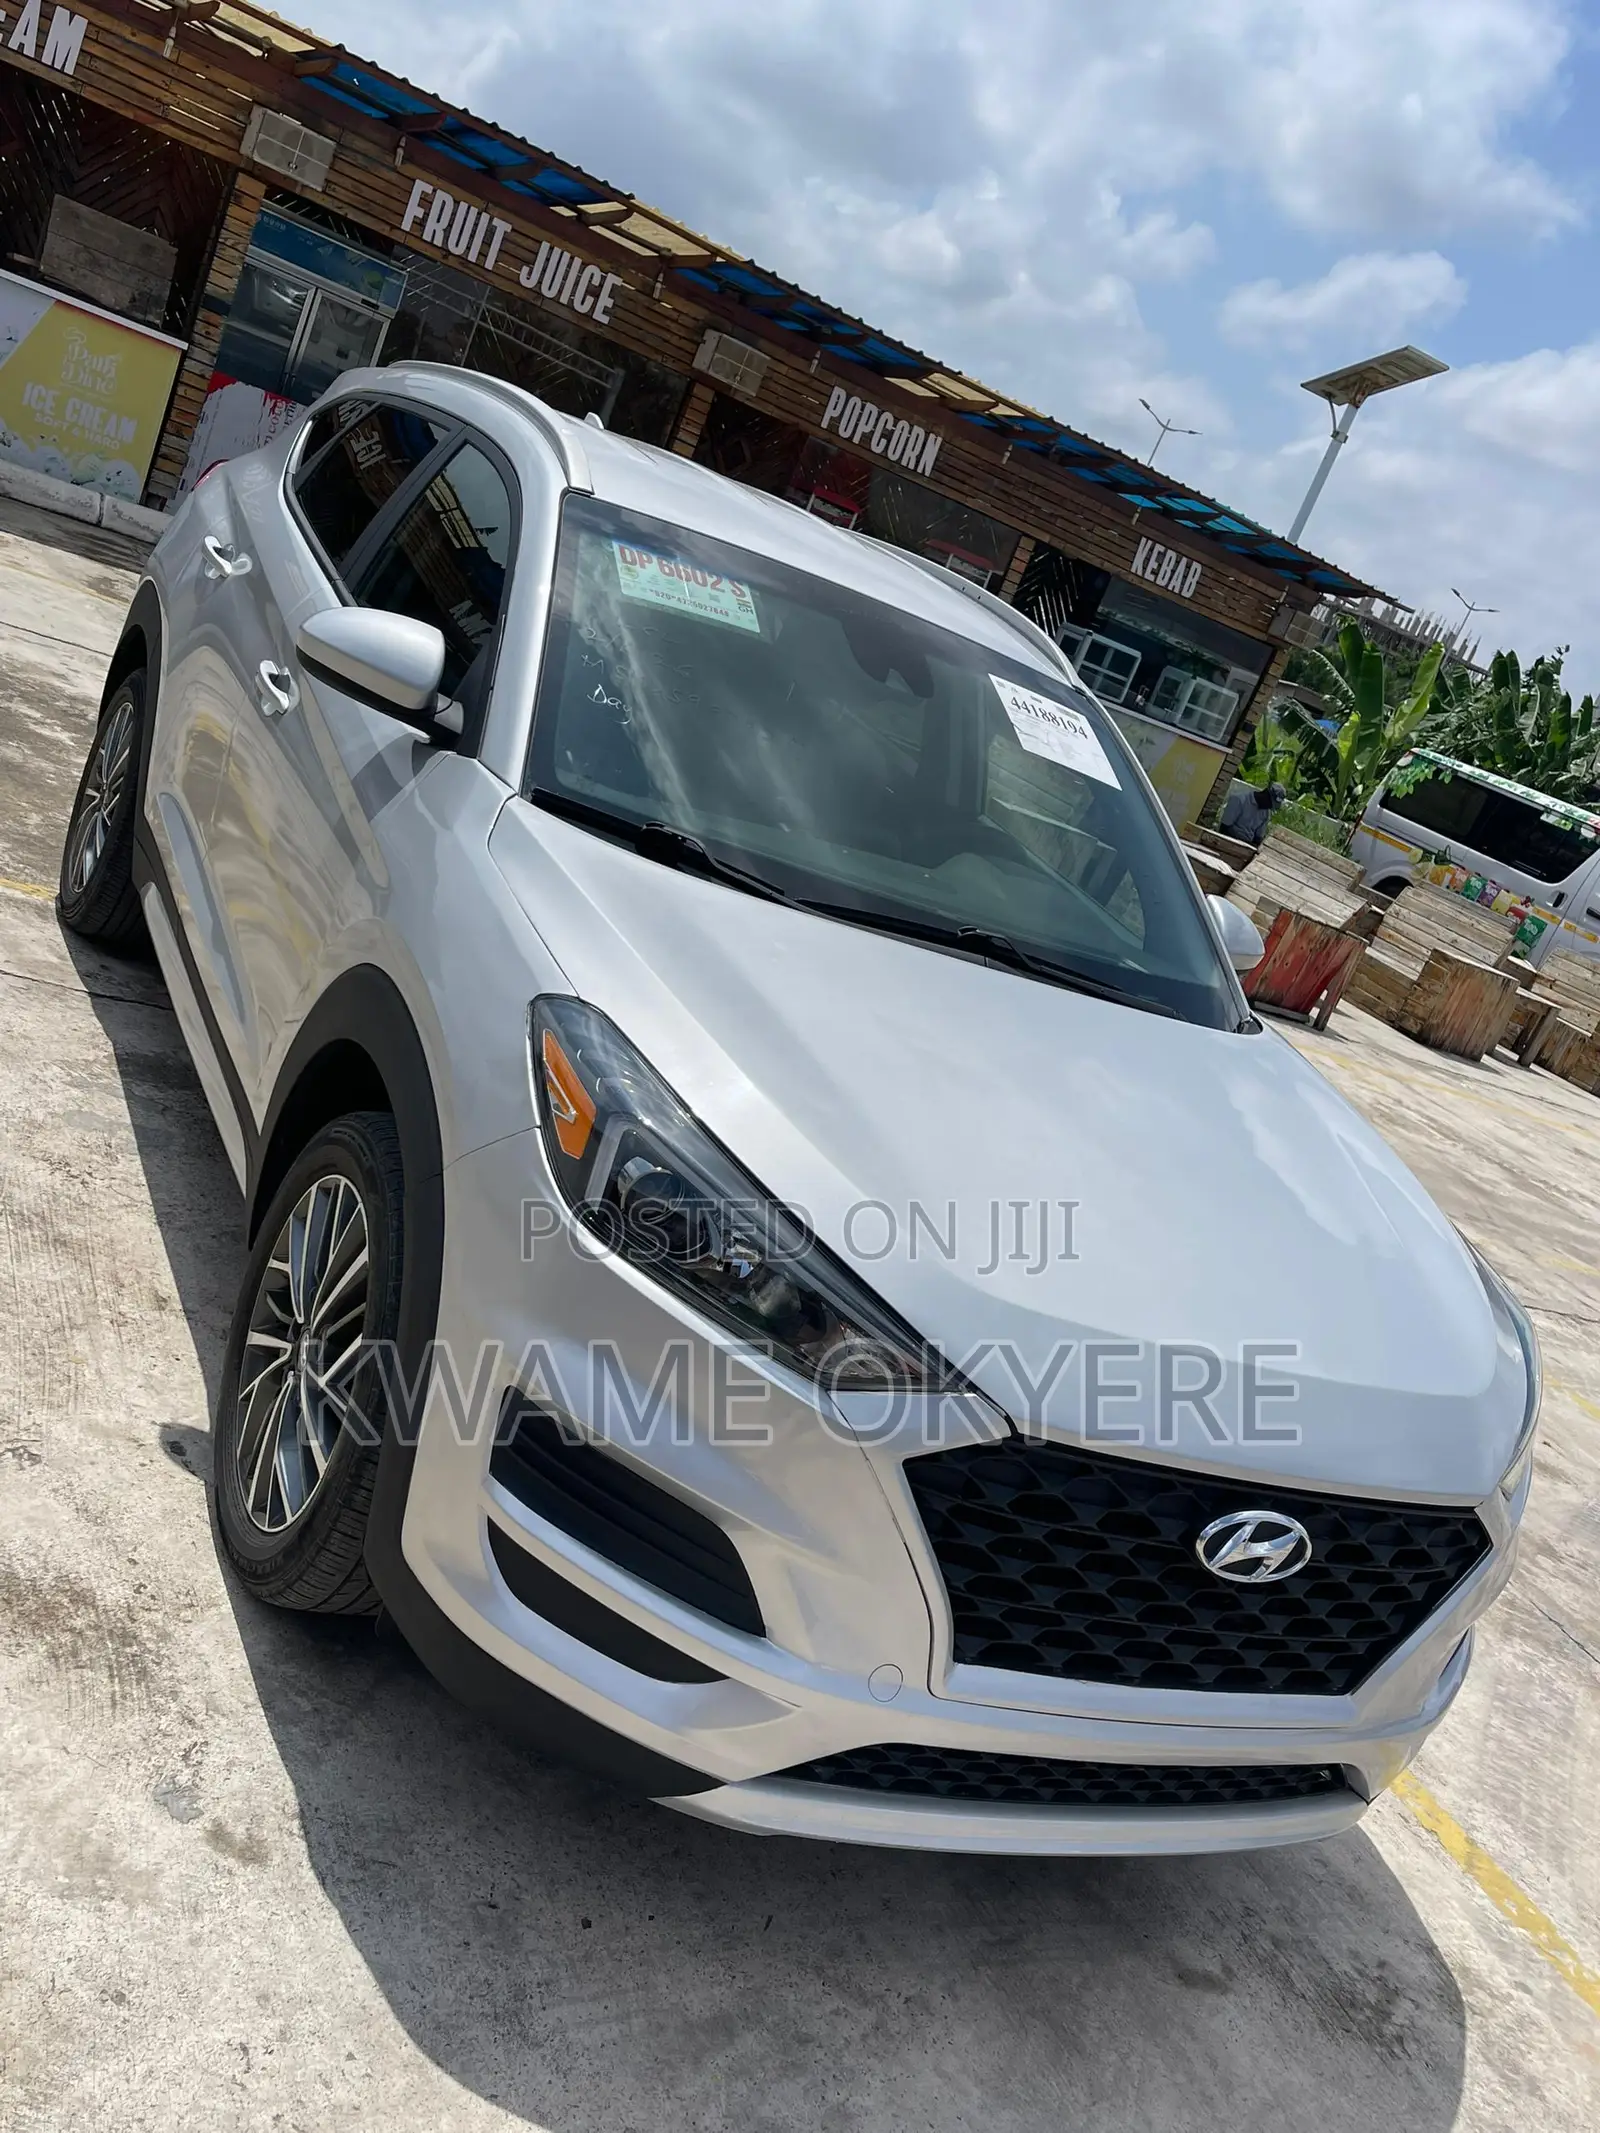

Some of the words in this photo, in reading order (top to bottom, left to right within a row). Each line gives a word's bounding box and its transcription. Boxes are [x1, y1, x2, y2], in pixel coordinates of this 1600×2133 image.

[0, 0, 88, 75] AM
[401, 179, 512, 271] FRUIT
[520, 240, 623, 325] JUICE
[22, 382, 60, 415] ICE
[65, 397, 138, 443] CREAM
[34, 413, 69, 431] SOFT
[820, 386, 943, 477] POPCORN
[619, 544, 653, 569] DP
[729, 580, 747, 599] S
[1131, 536, 1202, 598] KEBAB
[1011, 696, 1088, 739] 44188194
